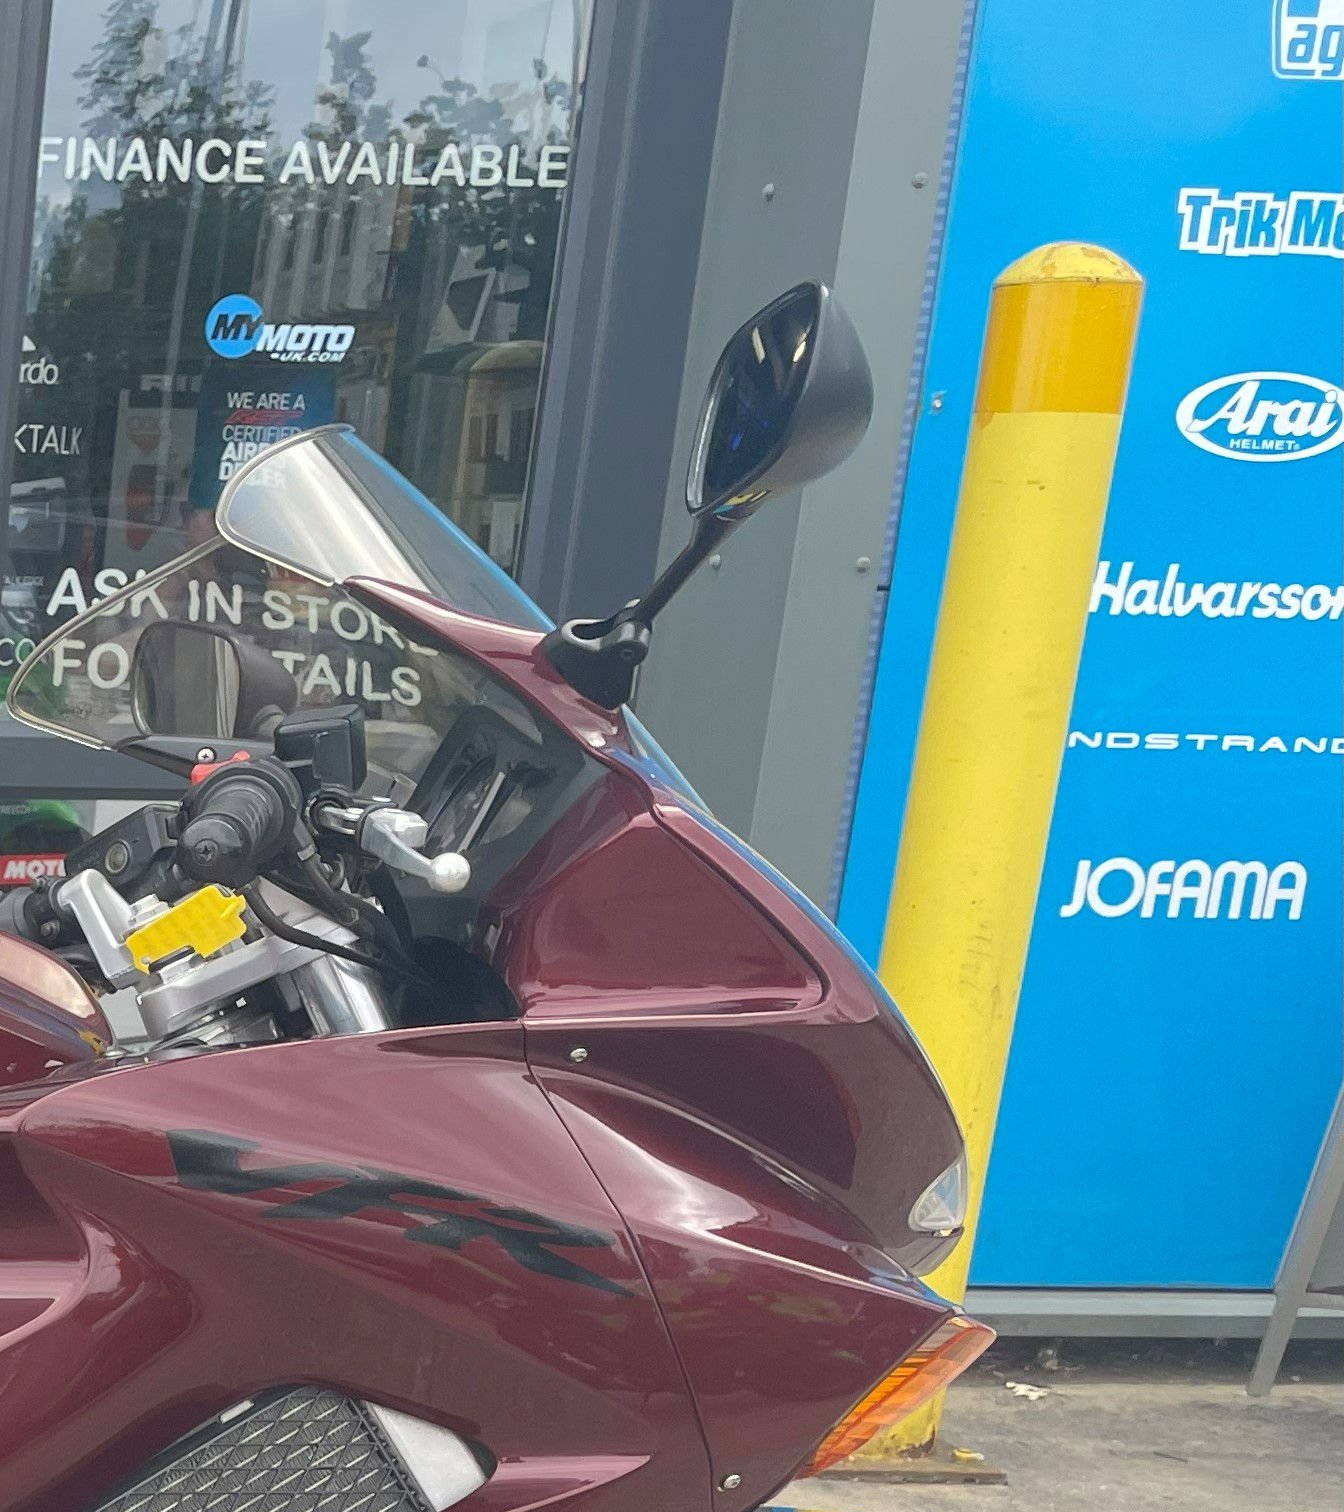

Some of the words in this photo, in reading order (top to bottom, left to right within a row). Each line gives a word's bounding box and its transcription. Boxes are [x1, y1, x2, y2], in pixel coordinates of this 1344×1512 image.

[38, 136, 267, 184] FINANCE
[278, 140, 570, 188] AVAILABLE
[226, 391, 255, 409] WE
[256, 393, 290, 410] ARE
[292, 394, 306, 411] A
[1186, 380, 1338, 437] Arai
[1229, 438, 1297, 451] HELMET
[46, 567, 169, 620] ASK
[188, 579, 243, 625] IN
[50, 637, 131, 690] FO
[272, 650, 422, 707] TAILS
[1068, 730, 1344, 754] NDSTRAN
[2, 858, 67, 880] MOT
[1060, 856, 1308, 920] JOFAMA
